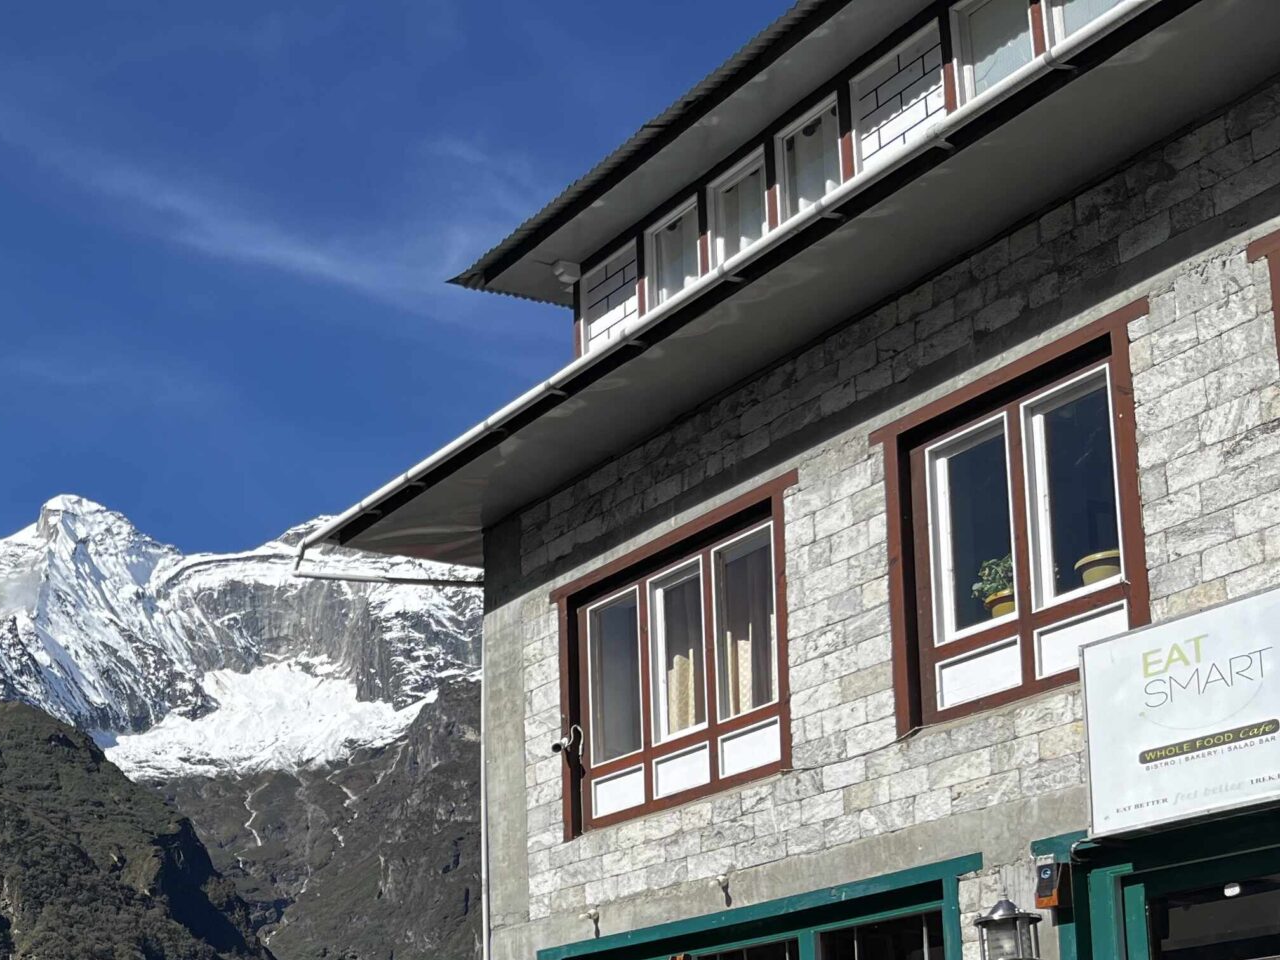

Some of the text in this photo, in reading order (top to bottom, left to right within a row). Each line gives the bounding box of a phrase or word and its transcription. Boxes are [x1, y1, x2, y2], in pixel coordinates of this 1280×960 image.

[1142, 634, 1209, 678] EAT
[1144, 647, 1273, 708] SMART
[1145, 743, 1190, 761] WHOLE
[1196, 733, 1233, 749] FOOD
[1145, 735, 1276, 771] BISTRO BAKERY SALAD BAR
[1134, 798, 1168, 810] BETTER
